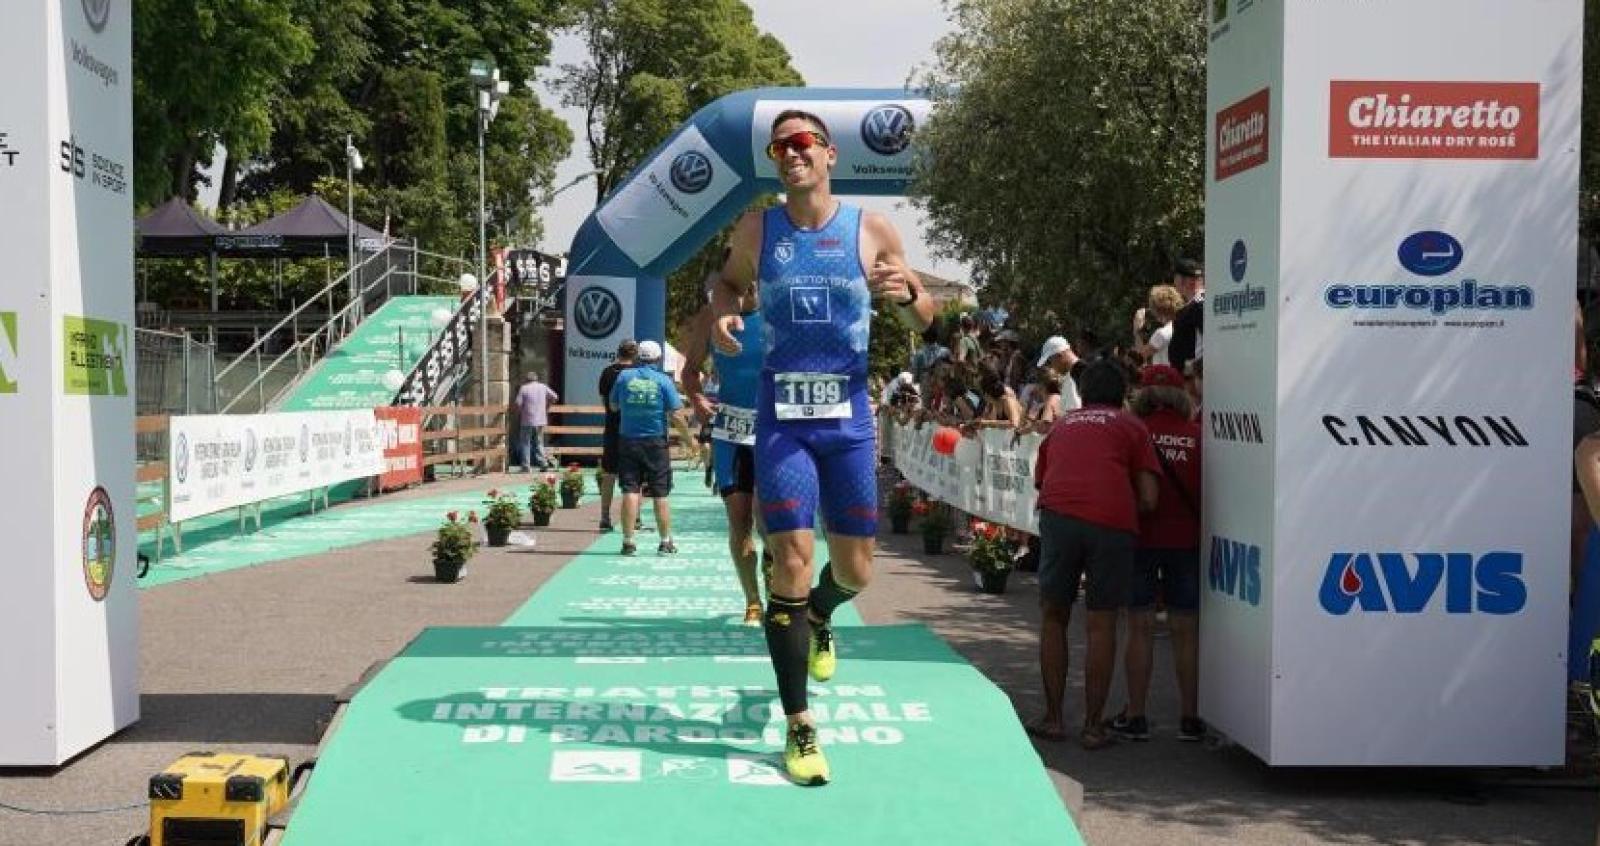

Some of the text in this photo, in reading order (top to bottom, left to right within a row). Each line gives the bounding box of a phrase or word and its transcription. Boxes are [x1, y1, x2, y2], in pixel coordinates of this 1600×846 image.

[1348, 93, 1520, 130] Chiaretto
[1353, 134, 1380, 146] THE
[1384, 134, 1441, 147] ITALIAN
[1445, 135, 1473, 147] DRY
[1213, 284, 1266, 317] europlan
[1325, 279, 1535, 316] europlan
[784, 381, 840, 404] 1199
[1152, 433, 1196, 448] UDICE
[1210, 411, 1263, 444] CANYON
[1321, 414, 1530, 447] CANYON
[1209, 536, 1262, 607] AVIS
[1318, 551, 1528, 616] AVIS
[461, 725, 904, 745] DI BARDOLNO
